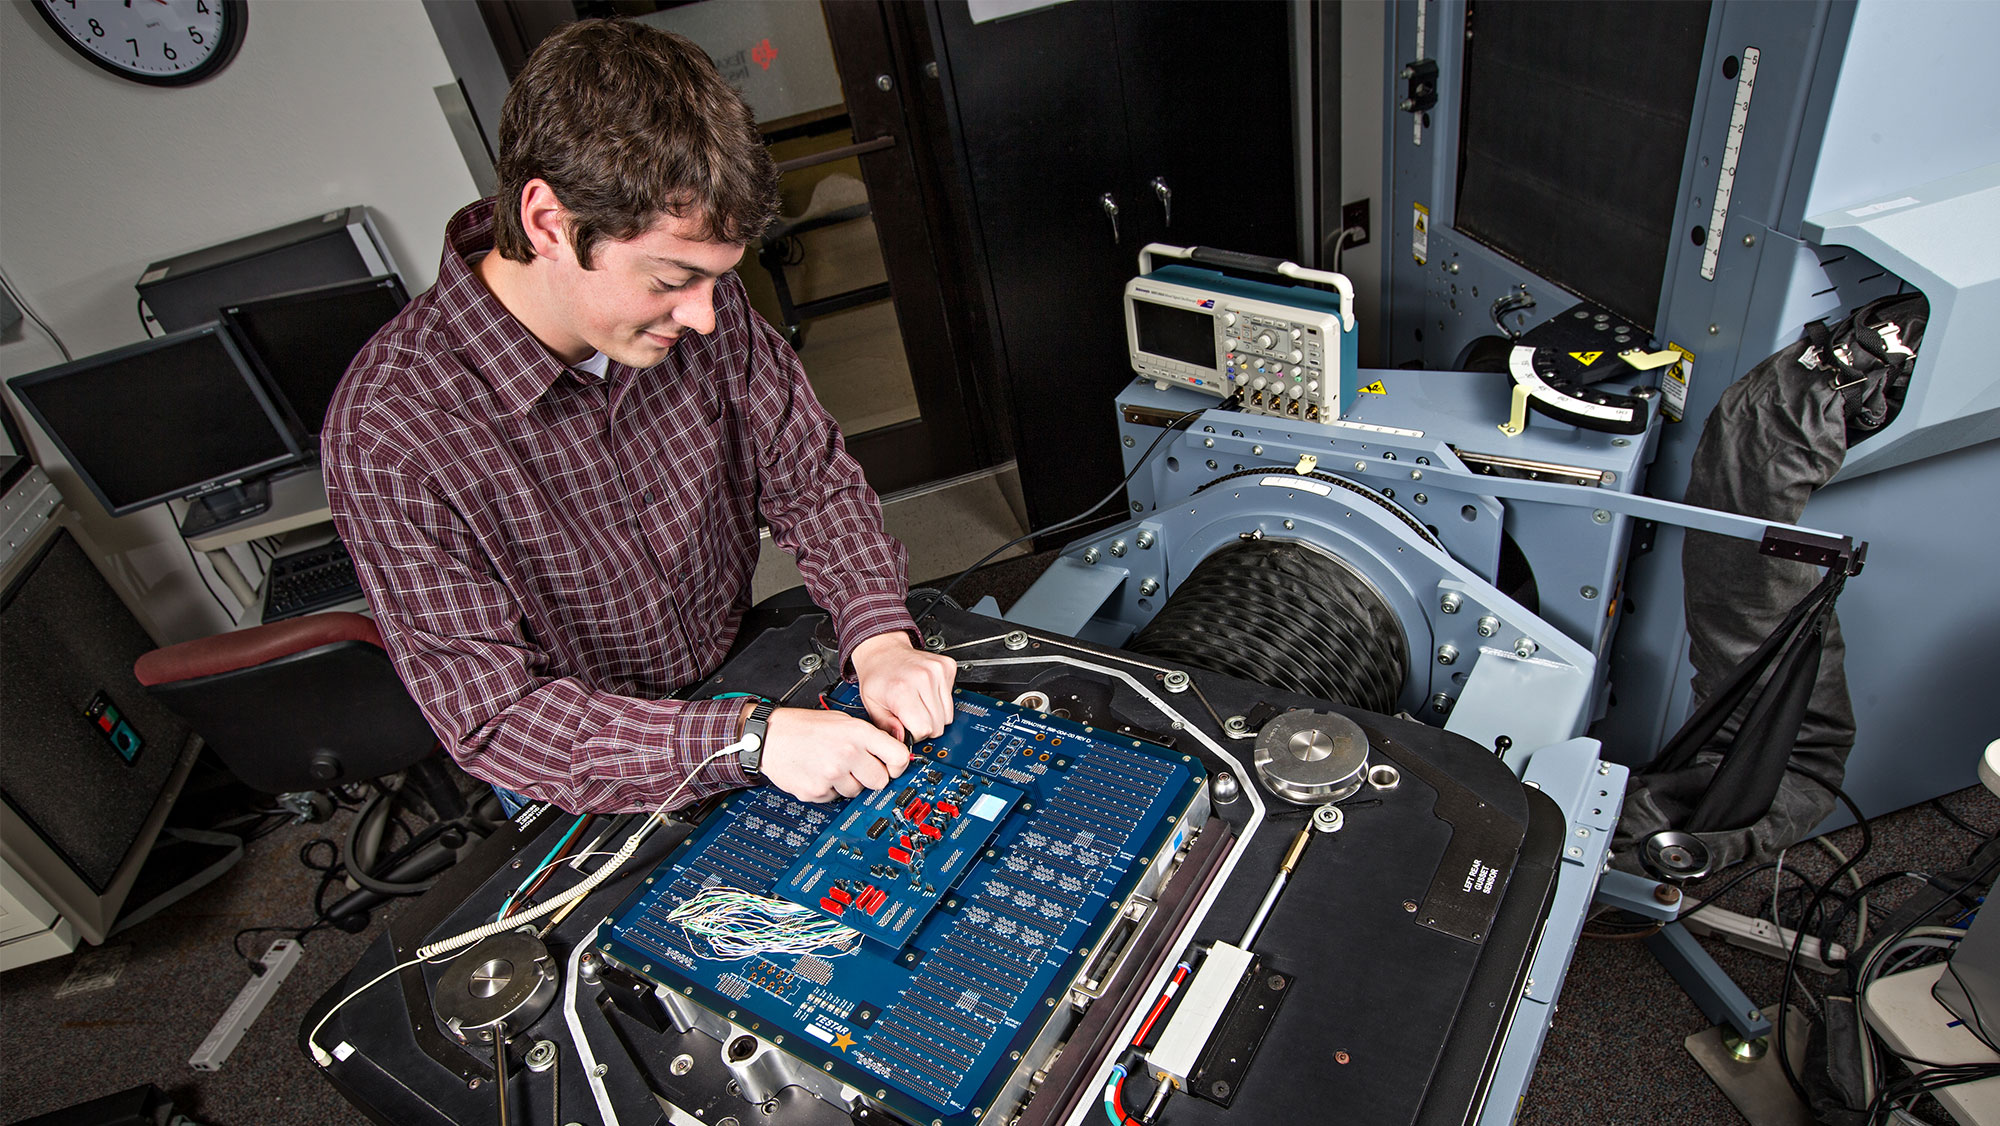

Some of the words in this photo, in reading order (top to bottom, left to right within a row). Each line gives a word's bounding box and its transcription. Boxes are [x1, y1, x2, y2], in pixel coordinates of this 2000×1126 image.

[88, 18, 105, 37] 8
[188, 26, 204, 44] 5
[126, 38, 139, 57] 7
[164, 42, 177, 60] 6
[1752, 56, 1758, 65] 5
[1747, 79, 1752, 88] 4
[1742, 102, 1748, 111] 3
[1737, 124, 1744, 133] 2
[1728, 167, 1736, 176] 0
[1720, 209, 1726, 217] 2
[1716, 229, 1721, 237] 3
[1462, 876, 1474, 892] LEFT
[1469, 859, 1482, 877] REAR
[1474, 865, 1490, 890] GUSSET
[1482, 868, 1498, 894] SENSOR
[815, 1014, 849, 1035] TESTAR
